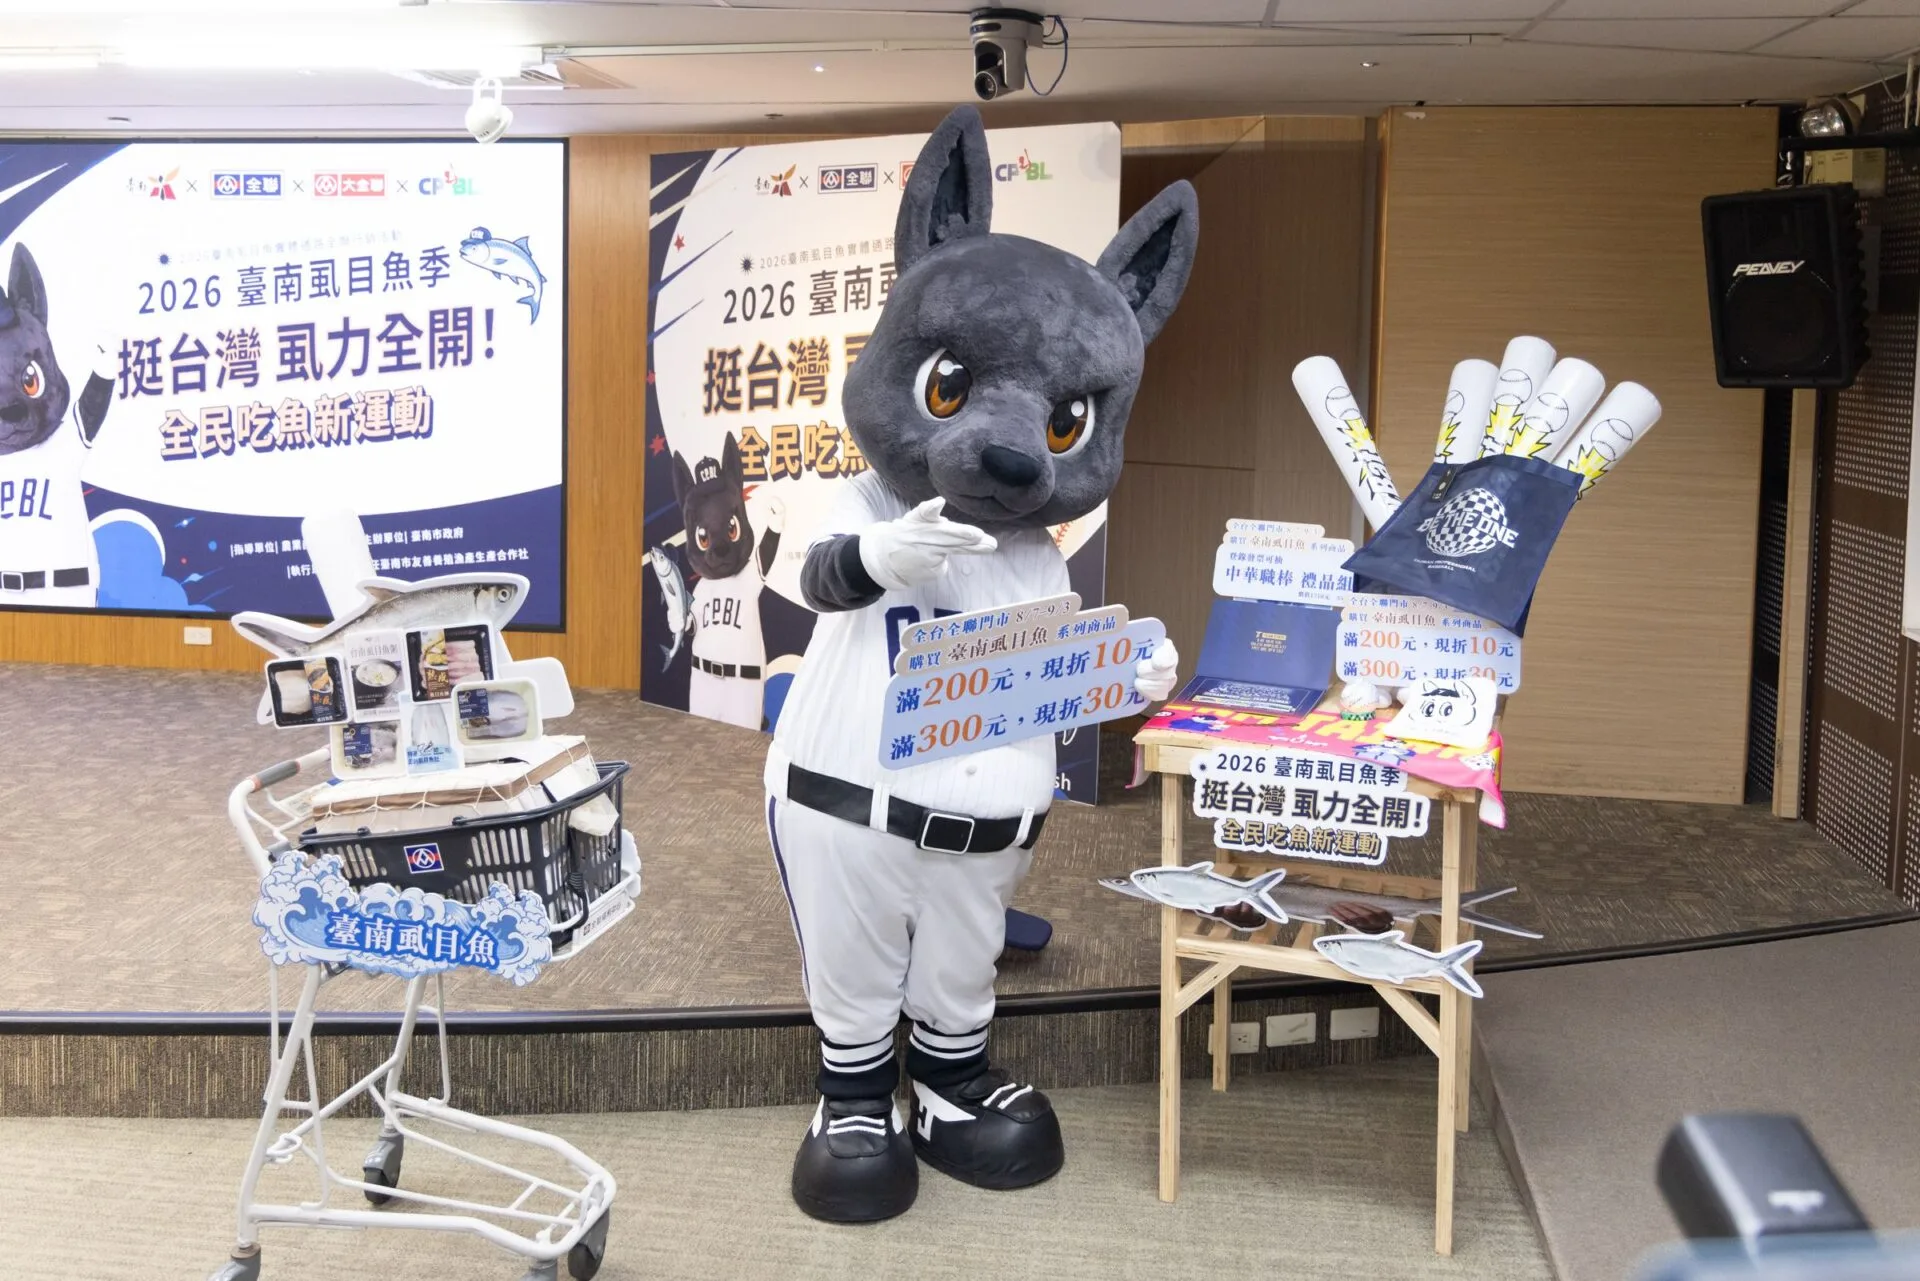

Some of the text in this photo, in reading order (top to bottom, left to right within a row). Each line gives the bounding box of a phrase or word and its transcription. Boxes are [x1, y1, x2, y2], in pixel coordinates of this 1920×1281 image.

[246, 176, 279, 193] 全聯
[846, 170, 873, 186] 全聯
[995, 162, 1054, 181] CPBL
[138, 276, 222, 315] 2026
[237, 245, 451, 307] 臺南虱目魚季
[1732, 260, 1805, 277] PEAVEY
[724, 280, 796, 324] 2026
[118, 308, 496, 400] 挺台灣 虱力全開!
[703, 336, 830, 416] 挺台灣
[159, 386, 434, 461] 全民吃魚新運動
[411, 527, 464, 542] 臺南市政府
[1416, 511, 1519, 548] BE THE ONE
[1225, 565, 1353, 592] 中華職棒 禮品組
[913, 613, 1010, 643] 全台全聯門市
[1372, 612, 1436, 627] 臺南虱目魚
[1441, 618, 1482, 629] 系列商品
[909, 617, 1116, 670] 購買 臺南虱目魚 系列商品
[1216, 754, 1400, 787] 2026 臺南虱目魚季
[1200, 778, 1286, 816] 挺台灣
[1221, 818, 1382, 858] 全民吃魚新運動
[329, 913, 496, 966] 臺南虱目魚
